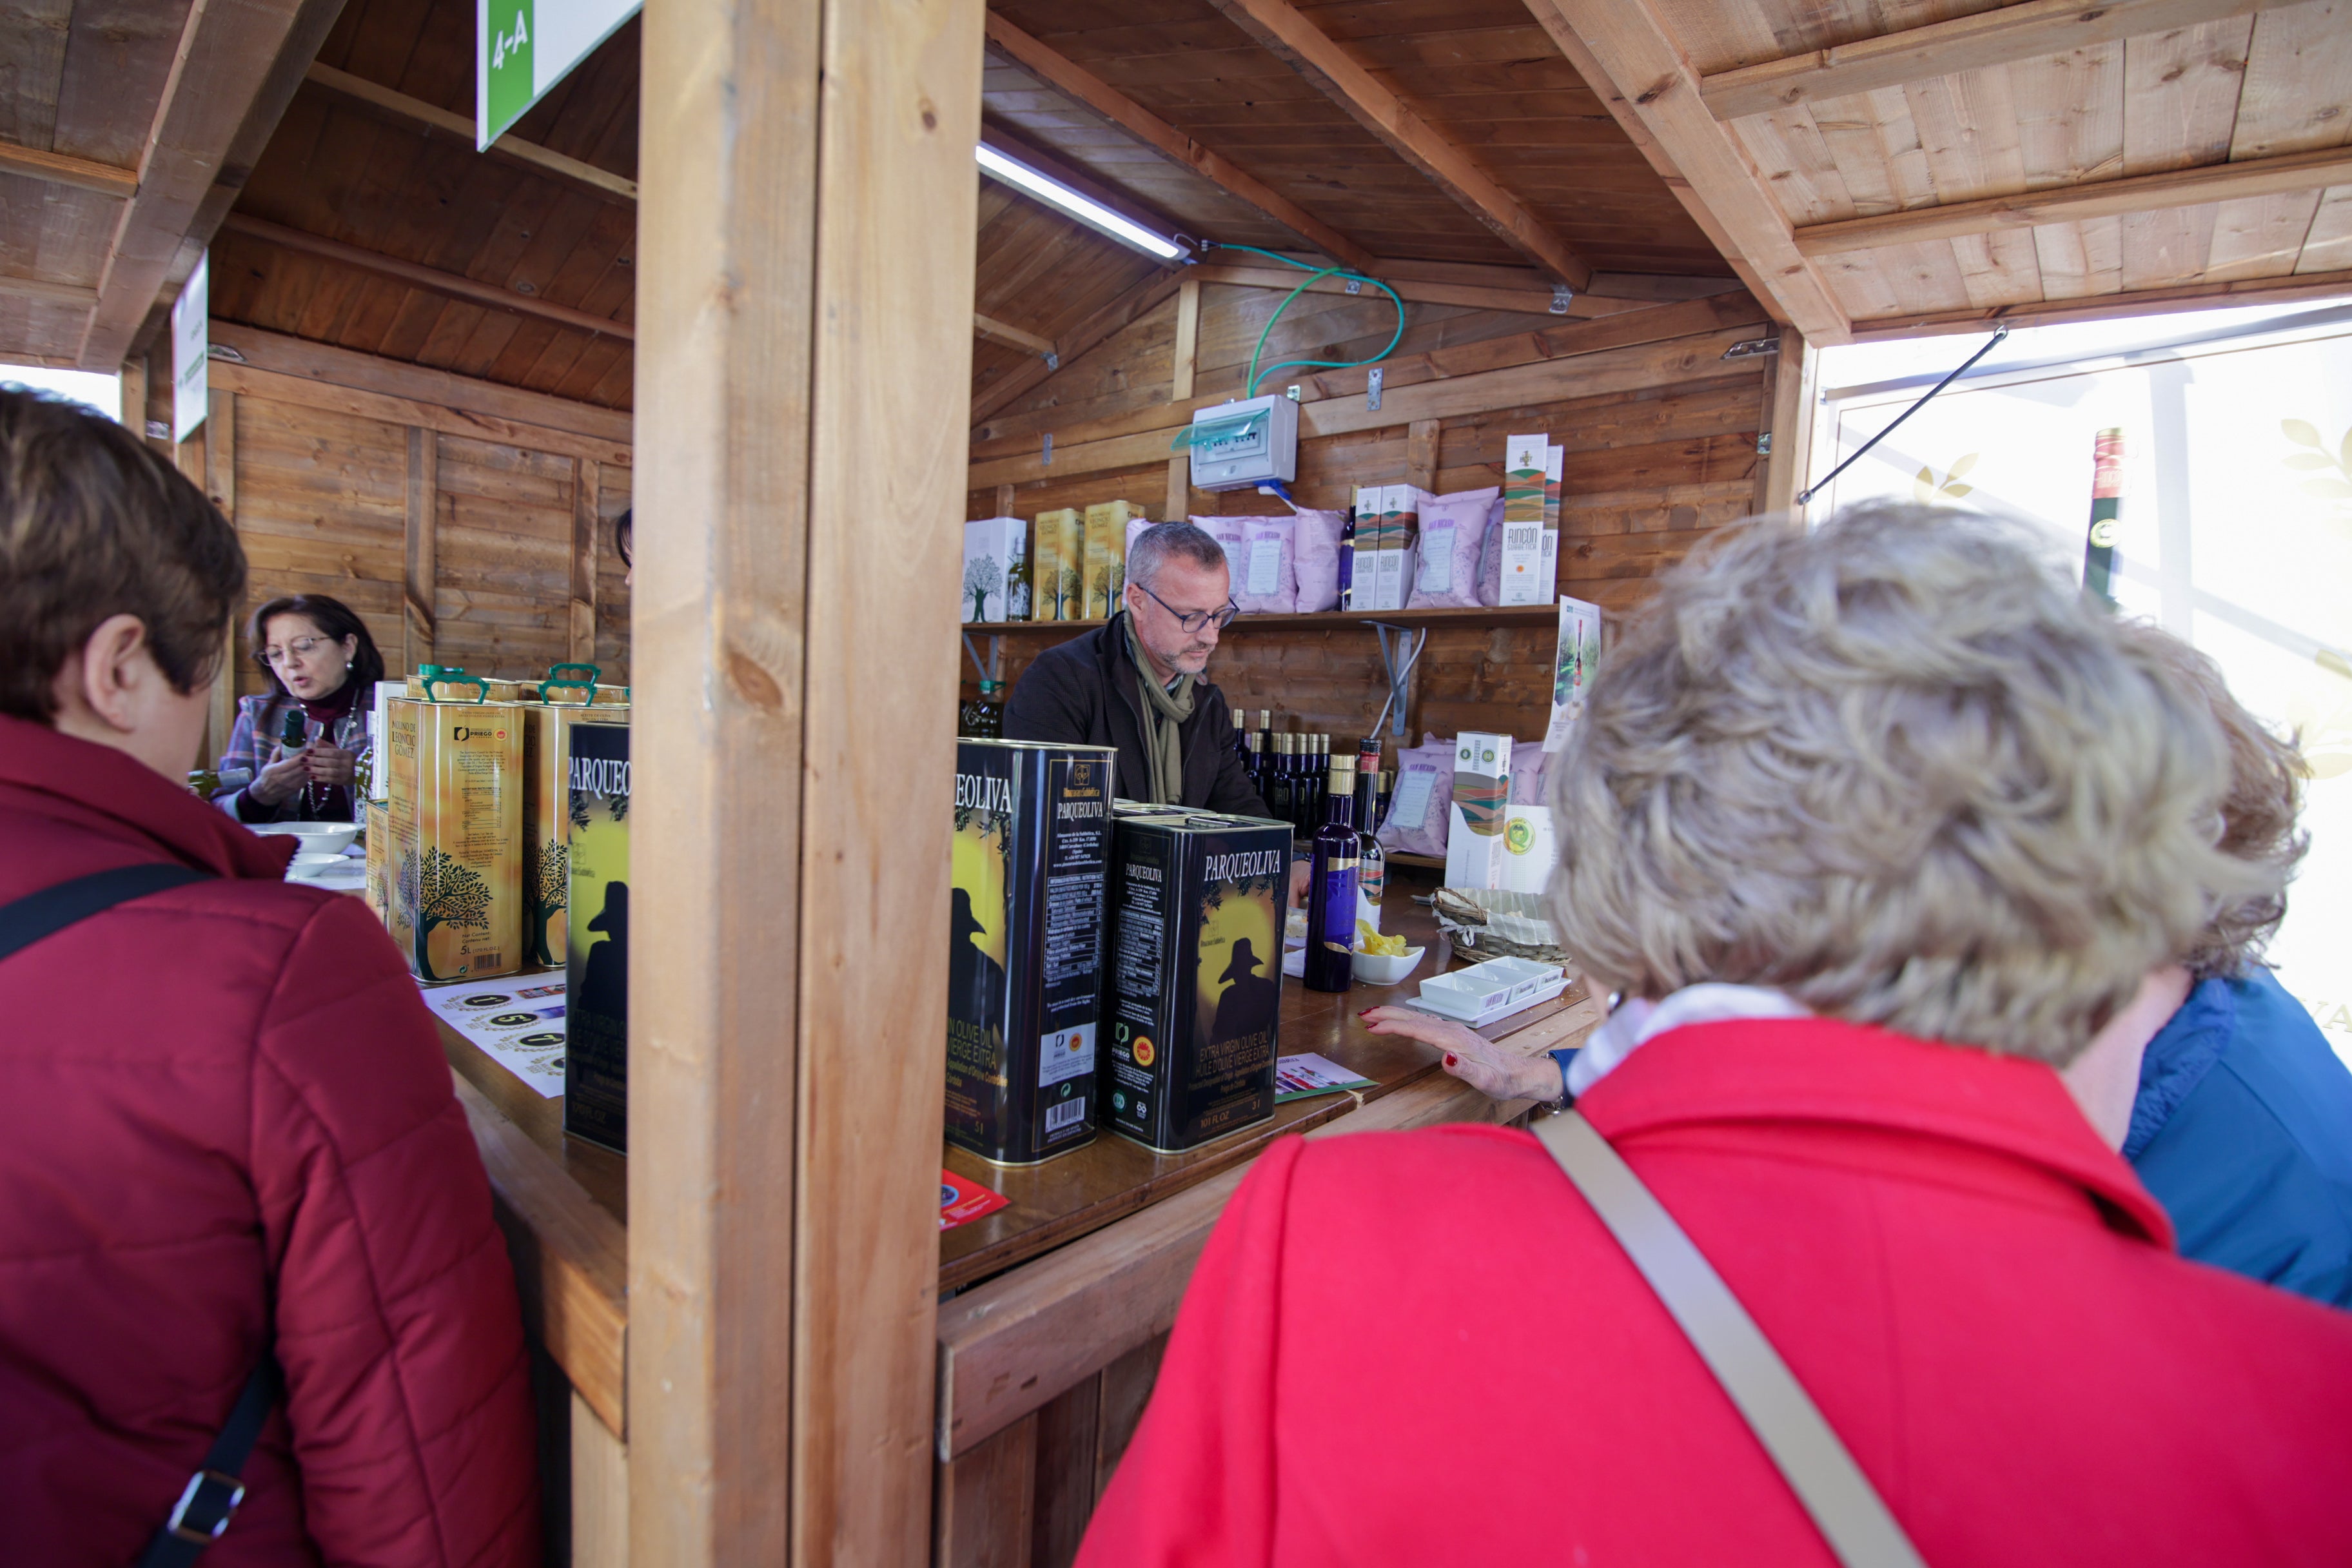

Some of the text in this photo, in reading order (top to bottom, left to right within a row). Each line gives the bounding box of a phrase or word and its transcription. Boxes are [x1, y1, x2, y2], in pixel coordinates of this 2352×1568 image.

[492, 9, 527, 70] 4-A
[568, 756, 632, 800] PARQUEO
[954, 774, 1012, 813] EOLIVA
[1057, 801, 1103, 822] PARQUEOLIVA
[1125, 863, 1162, 883] PARQUEOLIVA
[1204, 850, 1280, 884] PARQUEOLIVA
[460, 945, 471, 955] 5L
[956, 1020, 979, 1043] OLIVE
[980, 1028, 992, 1050] OIL
[1200, 1030, 1268, 1063] EXTRA VIRGIN OLIVE OIL
[973, 1045, 997, 1070] EXTRA
[1112, 1046, 1130, 1058] PRIEGO
[1195, 1044, 1269, 1078] HUILE D'OLIVE VIERGE EXTRA
[1200, 1110, 1230, 1128] 101 FL OZ
